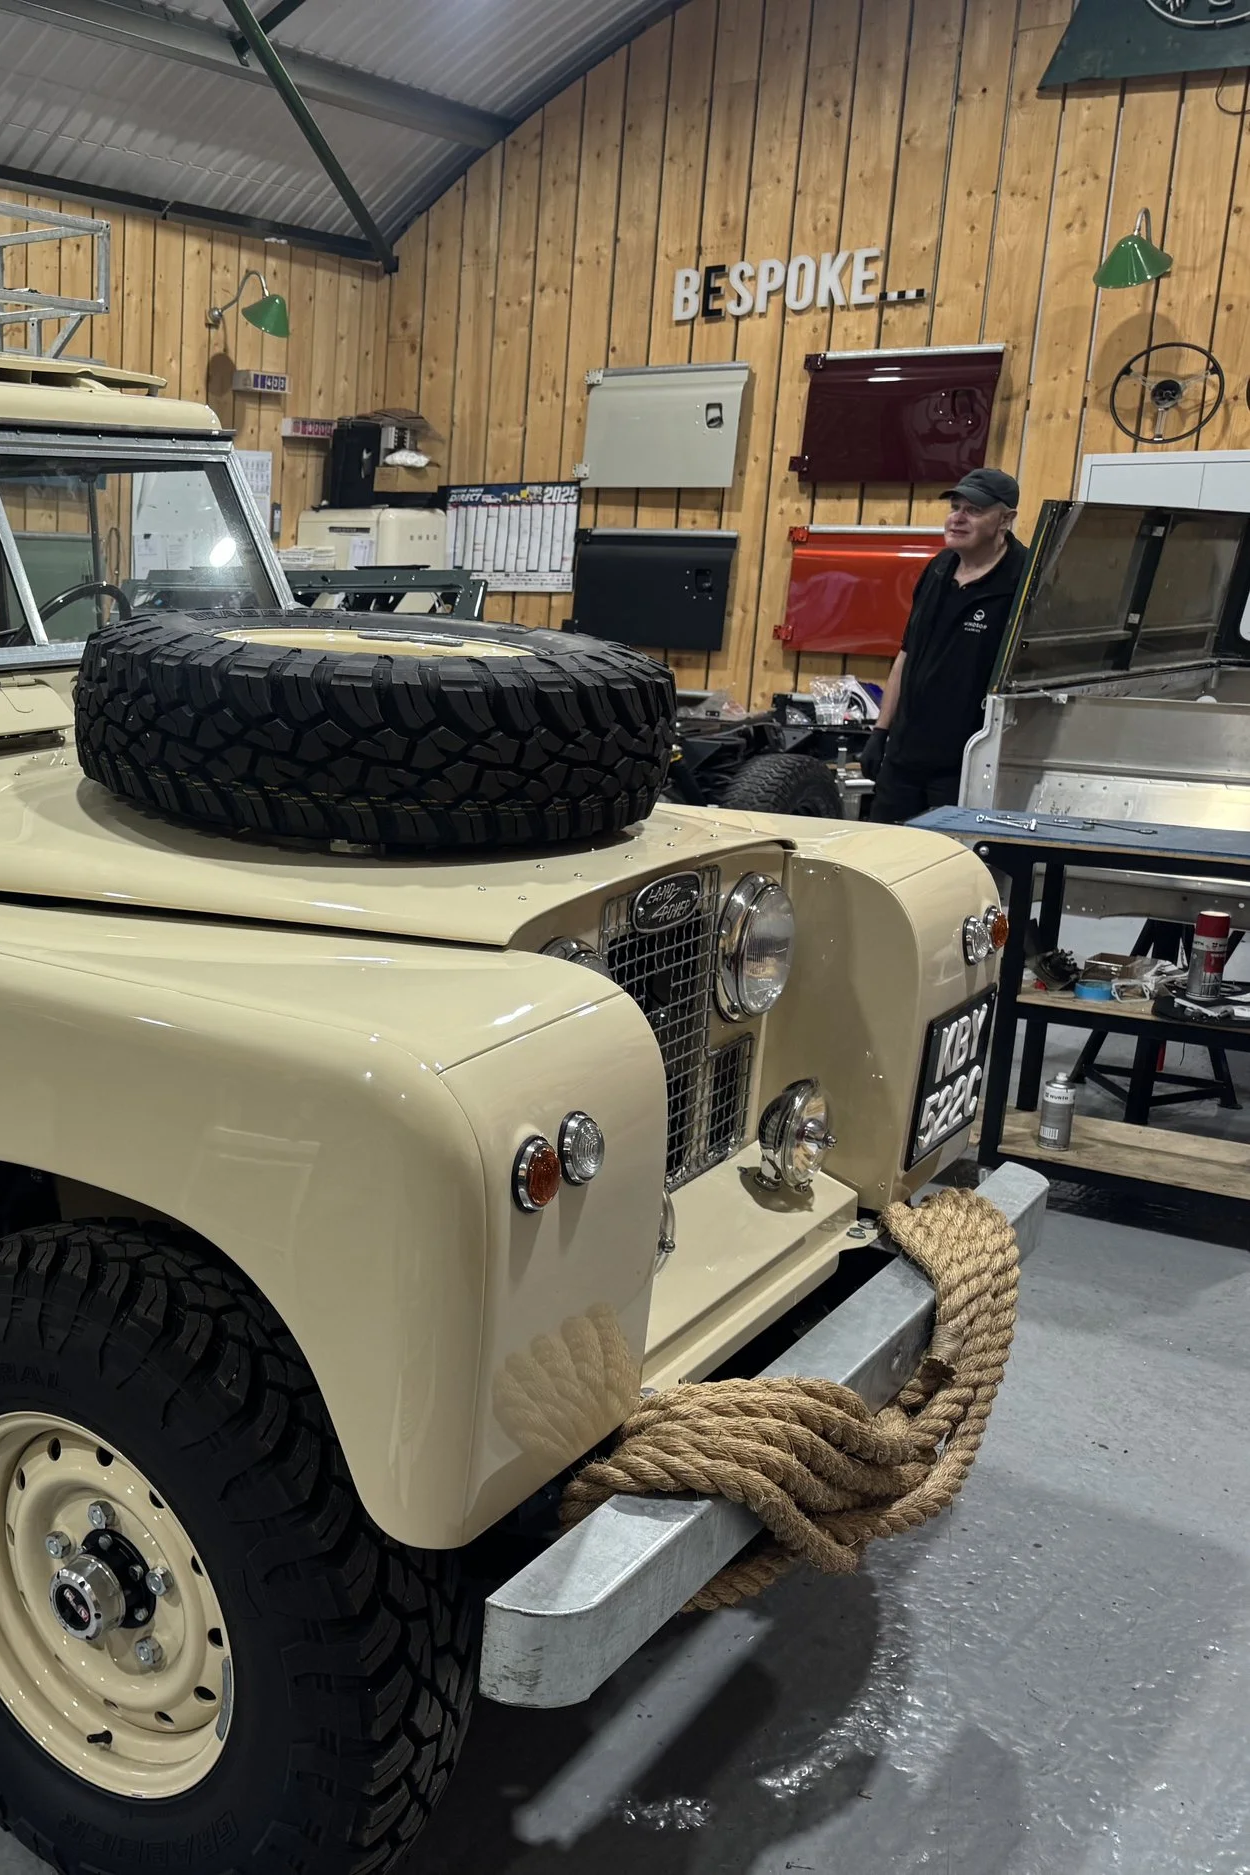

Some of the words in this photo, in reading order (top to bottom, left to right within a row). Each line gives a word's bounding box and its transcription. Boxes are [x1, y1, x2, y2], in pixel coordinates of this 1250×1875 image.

[672, 248, 925, 321] BESPOKE...
[543, 486, 578, 503] 2025
[646, 883, 677, 904] LAND
[935, 1003, 988, 1083] KBY
[918, 1065, 982, 1148] 522C
